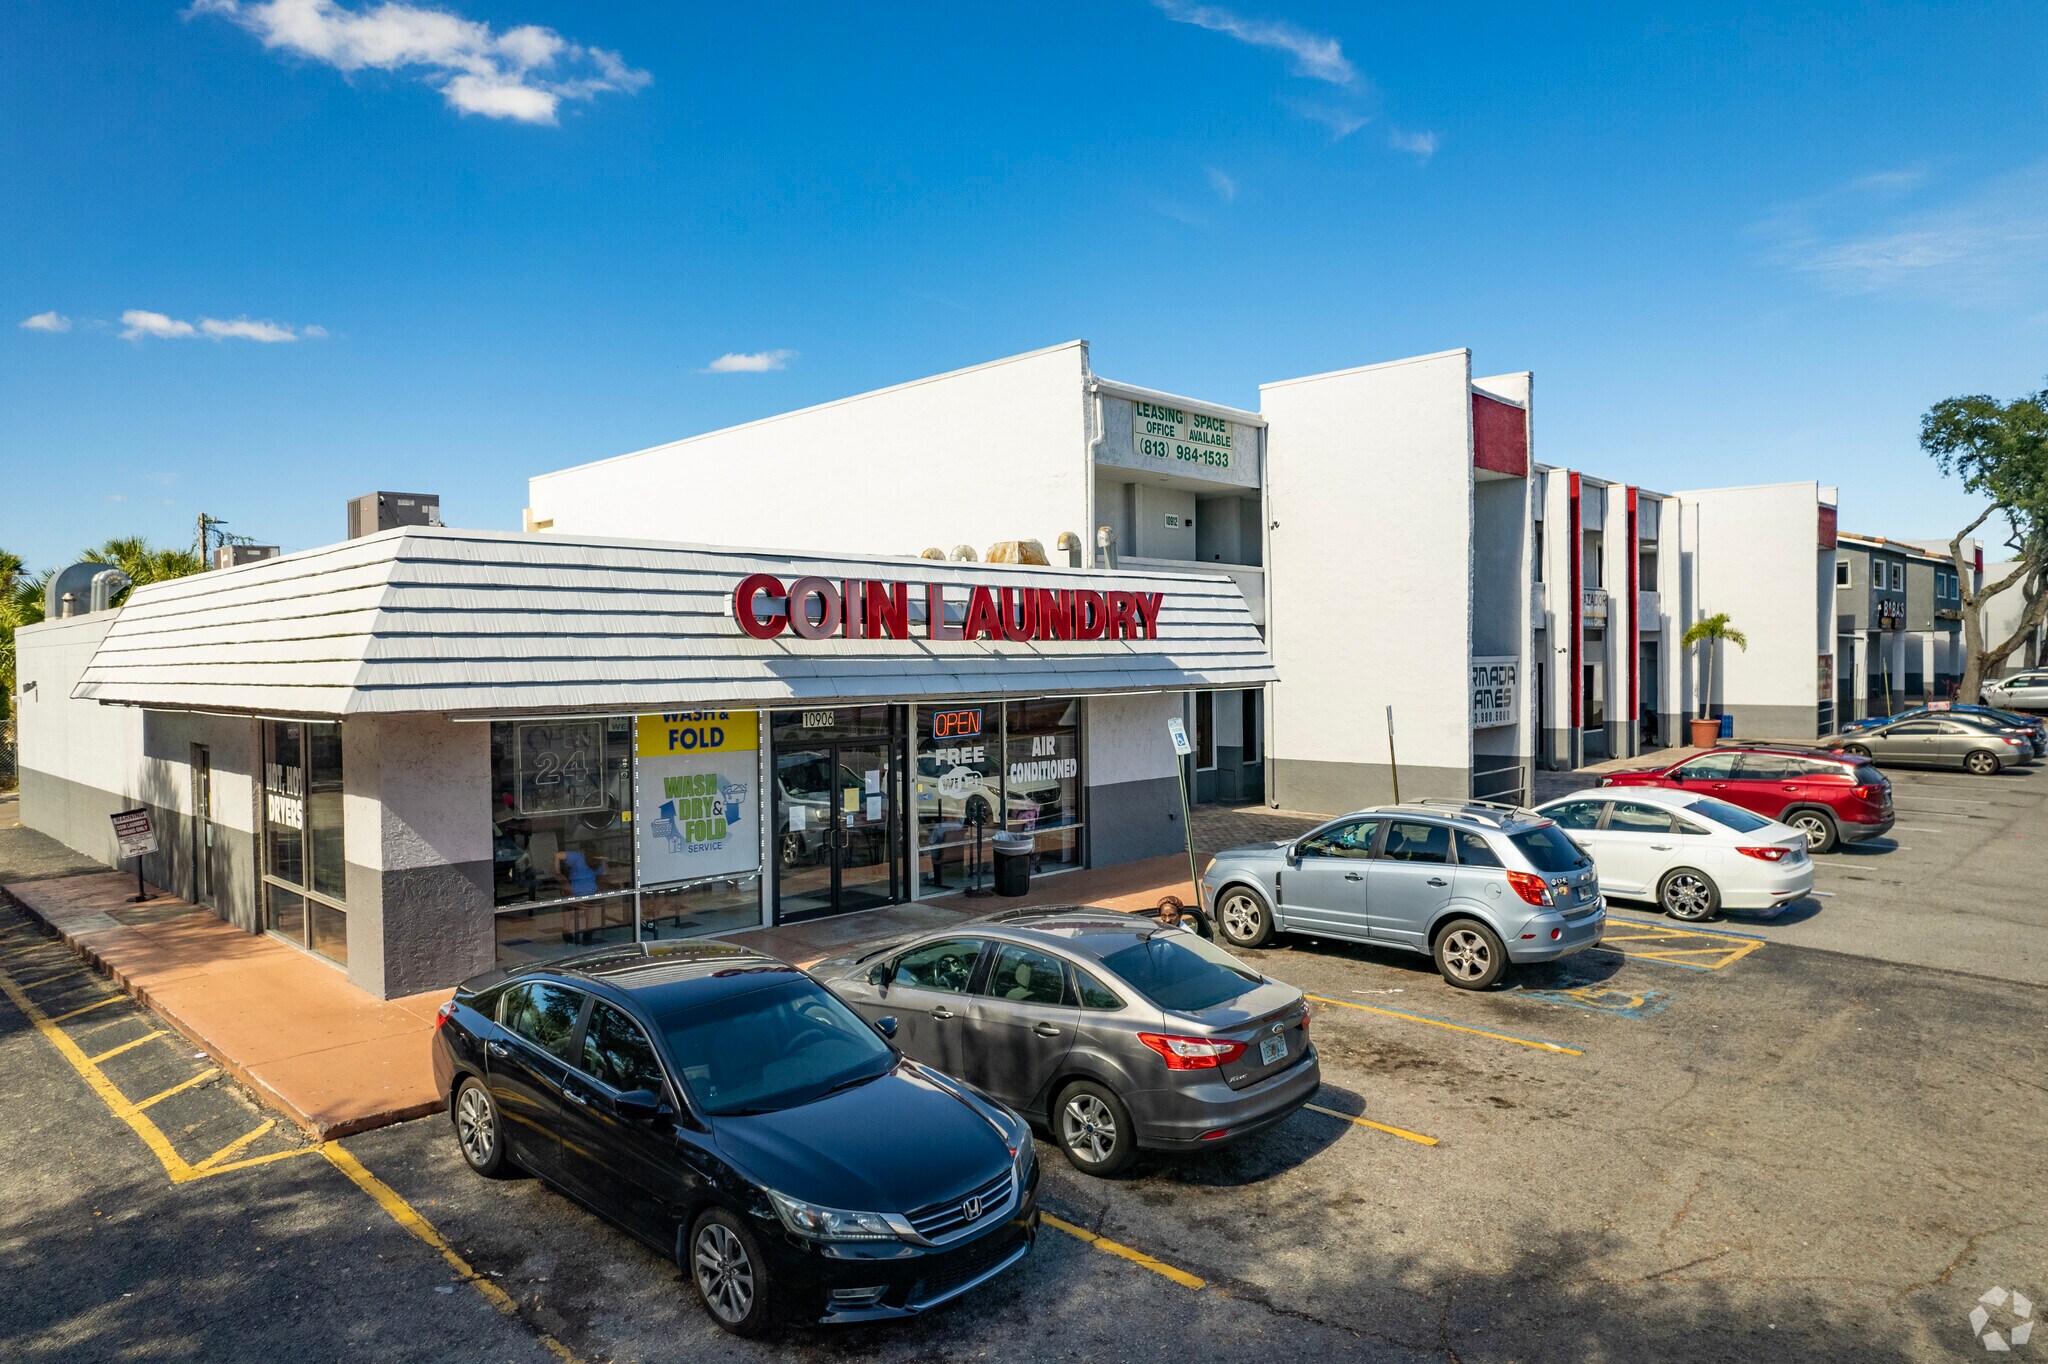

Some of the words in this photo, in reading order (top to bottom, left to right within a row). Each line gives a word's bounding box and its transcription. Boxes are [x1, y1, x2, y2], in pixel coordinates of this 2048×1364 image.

[1136, 401, 1183, 425] LEASING
[1193, 414, 1226, 433] SPACE
[1146, 420, 1175, 437] OFFICE
[1189, 429, 1231, 447] AVAILABLE
[1140, 437, 1170, 458] (813)
[1176, 444, 1229, 468] 984-1533
[732, 573, 908, 641] COIN
[926, 583, 1164, 643] LAUNDRY
[803, 711, 834, 727] 10906
[935, 711, 980, 738] OPEN
[669, 726, 725, 750] FOLD
[1032, 736, 1056, 757] AIR
[534, 751, 589, 785] 24
[935, 746, 985, 766] FREE
[1010, 758, 1077, 784] CONDITIONED
[663, 774, 717, 799] WASH
[268, 794, 303, 830] DRYERS
[678, 796, 714, 821] DRY
[712, 800, 723, 816] &
[685, 818, 727, 843] FOLD
[688, 841, 722, 854] SERVICE
